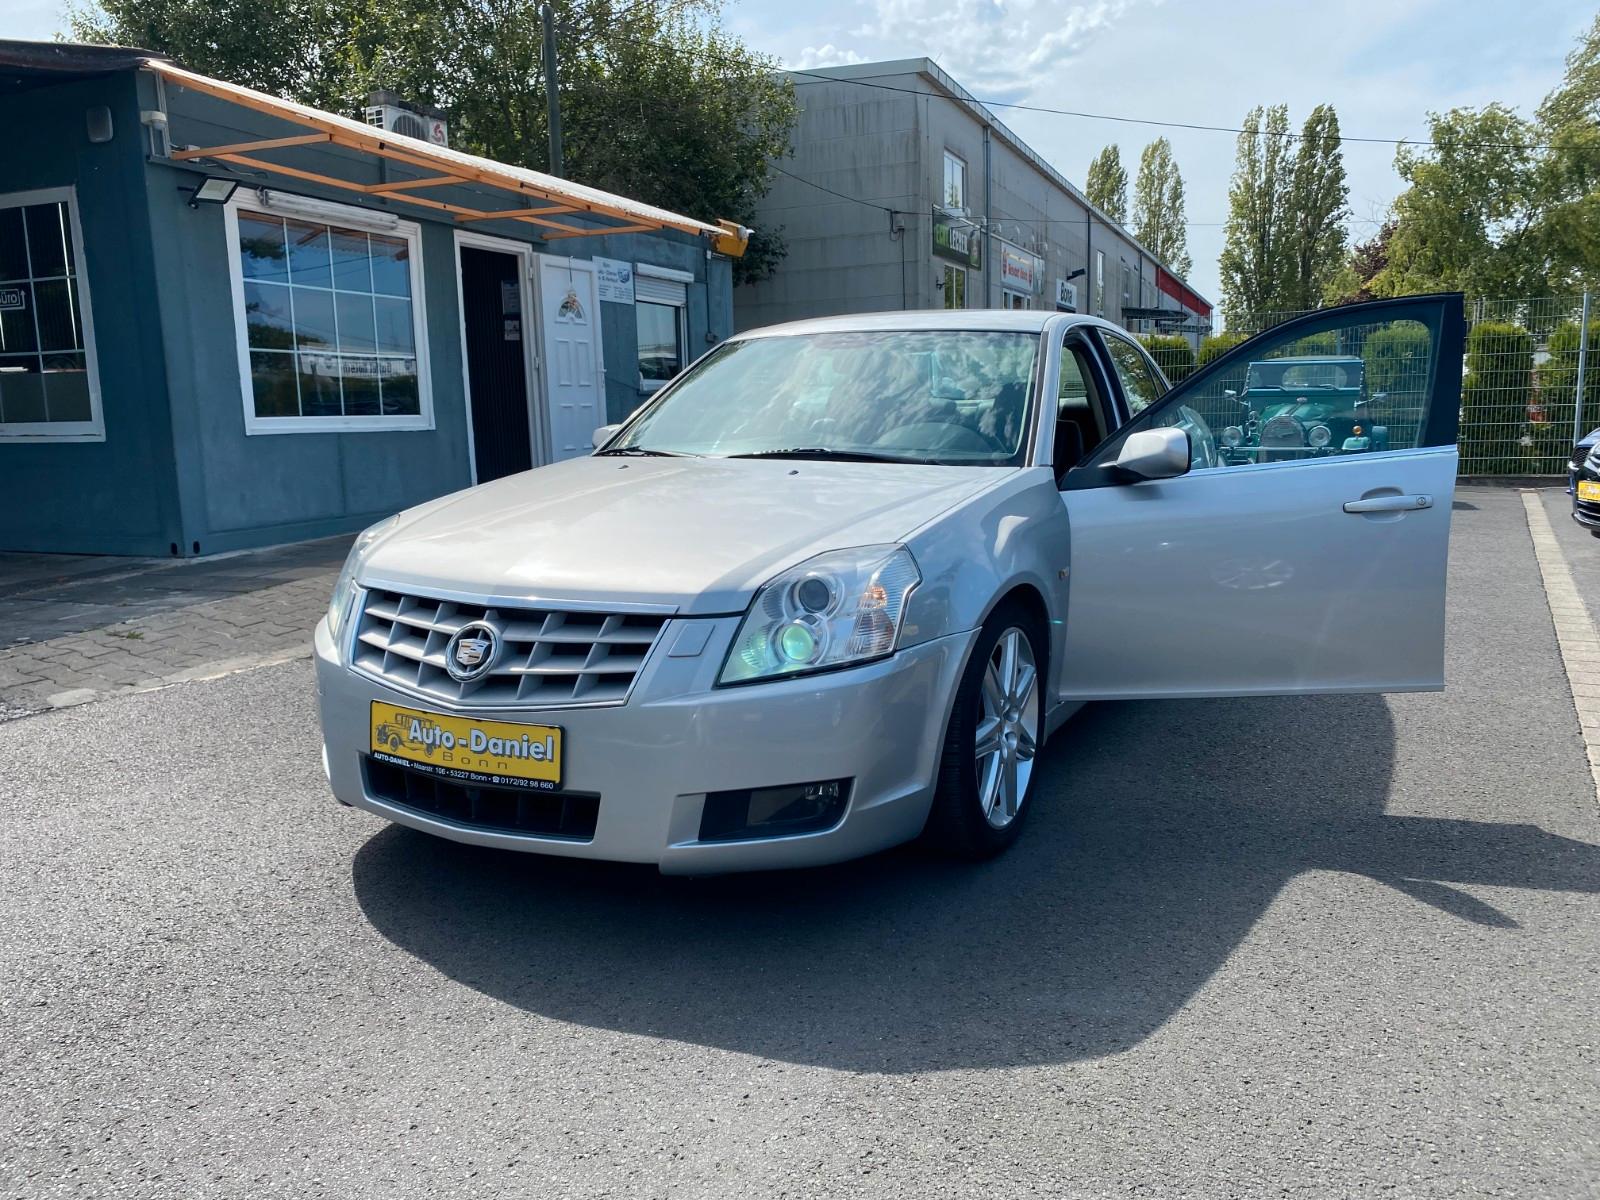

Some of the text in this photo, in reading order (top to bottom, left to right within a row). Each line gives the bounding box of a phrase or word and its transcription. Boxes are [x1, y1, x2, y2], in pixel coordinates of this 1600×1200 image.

[409, 719, 554, 760] Auto-Daniel
[374, 752, 410, 767] AUTO-DANIEL
[450, 770, 469, 779] 53227
[471, 772, 488, 782] Bonn
[529, 780, 539, 788] 98
[443, 751, 508, 770] Bonn
